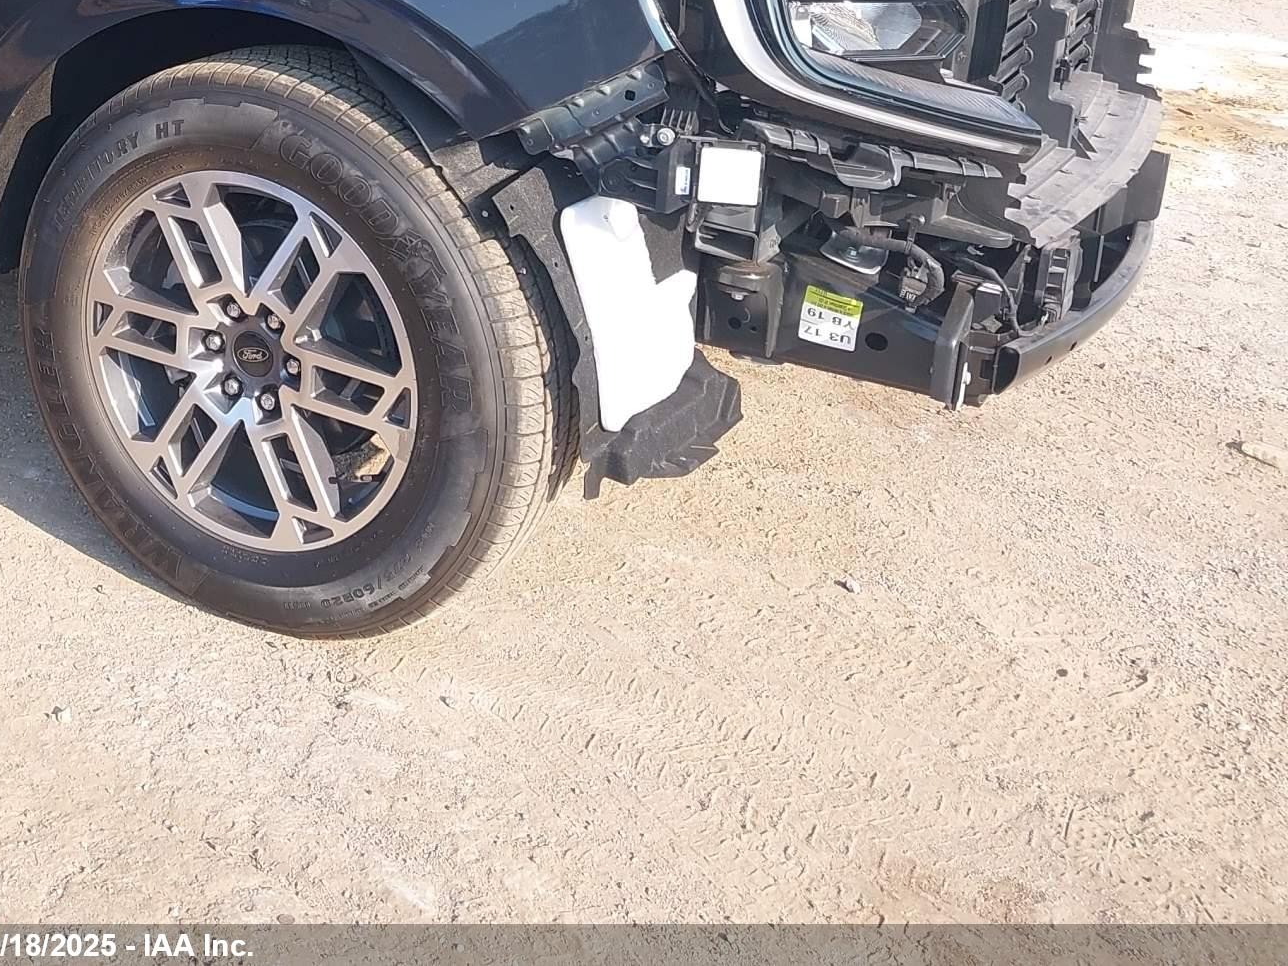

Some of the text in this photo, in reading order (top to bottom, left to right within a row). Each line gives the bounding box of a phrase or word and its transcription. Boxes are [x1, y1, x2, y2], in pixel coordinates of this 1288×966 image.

[155, 119, 185, 140] HT
[278, 133, 473, 412] GOODYEAR
[807, 307, 825, 320] 19
[803, 325, 823, 337] 17
